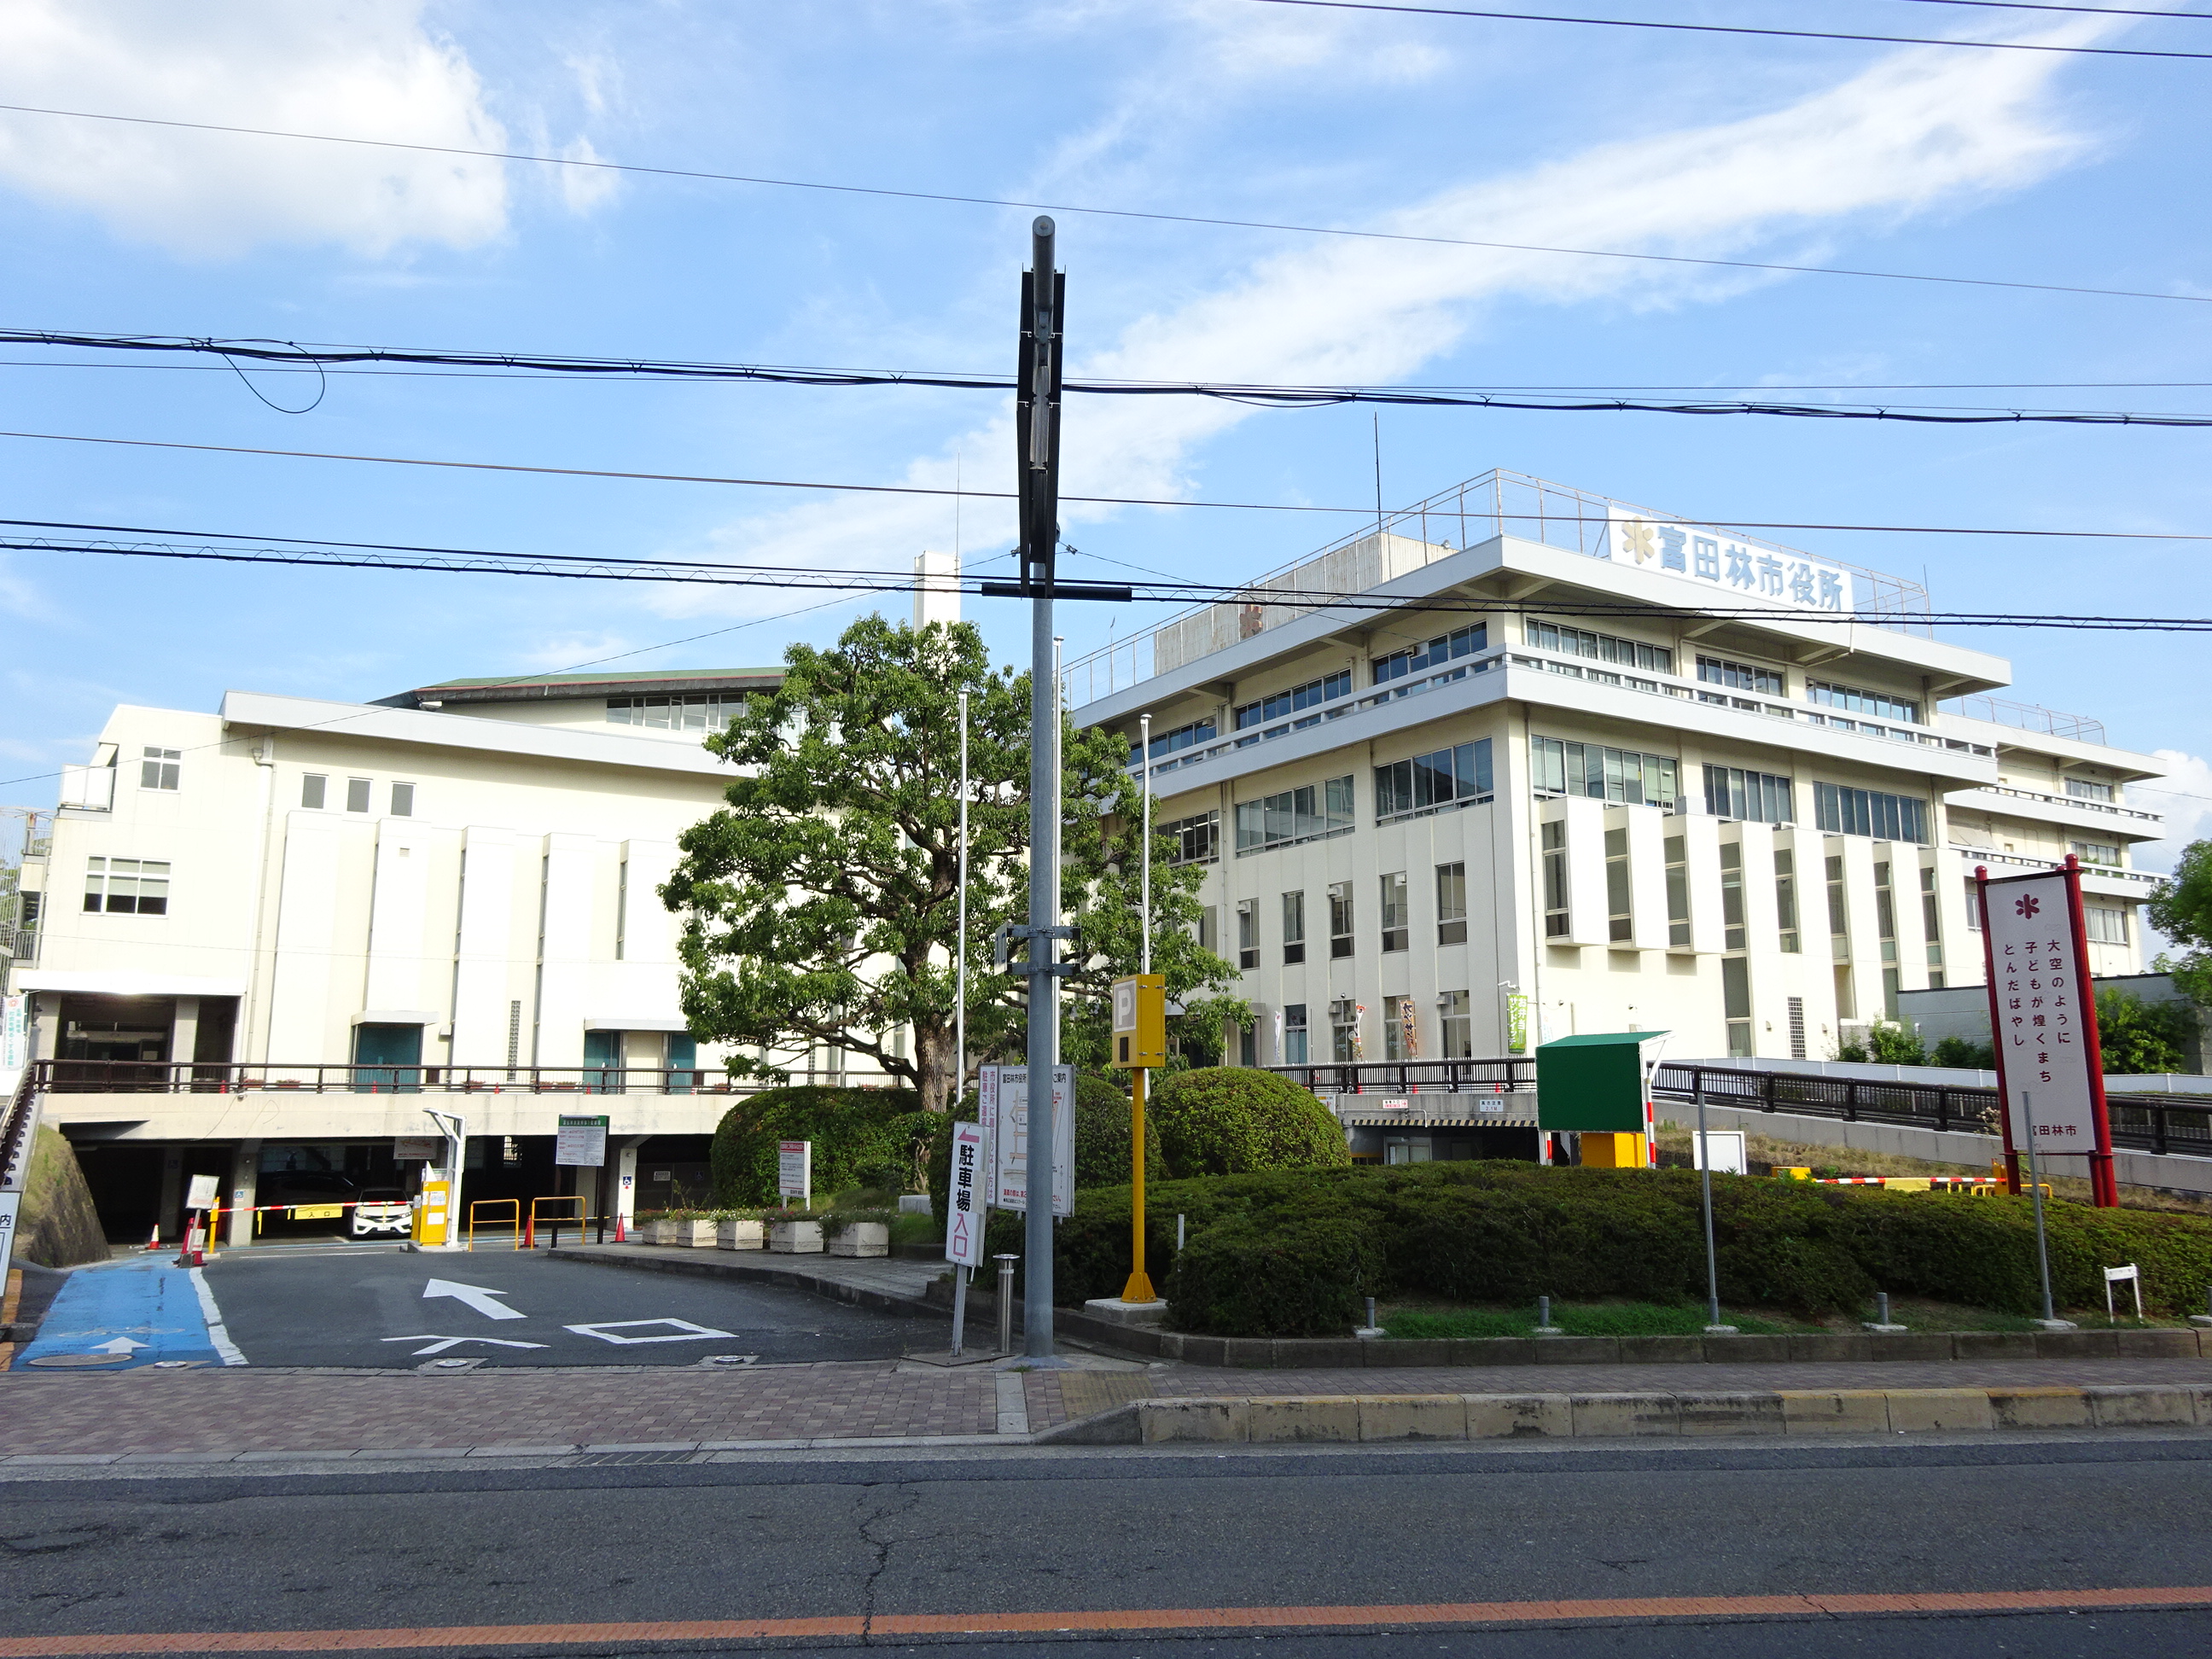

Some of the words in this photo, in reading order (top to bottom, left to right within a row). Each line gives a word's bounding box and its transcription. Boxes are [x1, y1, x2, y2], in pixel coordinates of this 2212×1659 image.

[1658, 525, 1843, 611] 富田林市役所
[1118, 989, 1132, 1026] P
[1509, 997, 1518, 1046] サンドイッチ
[1517, 997, 1527, 1030] お弁当
[2005, 944, 2024, 1046] とんだばやし
[2025, 941, 2052, 1083] 子どもが煌くまち
[2047, 940, 2070, 1045] 大空のように
[0, 1214, 12, 1226] 内
[952, 1144, 975, 1257] 駐車場入口
